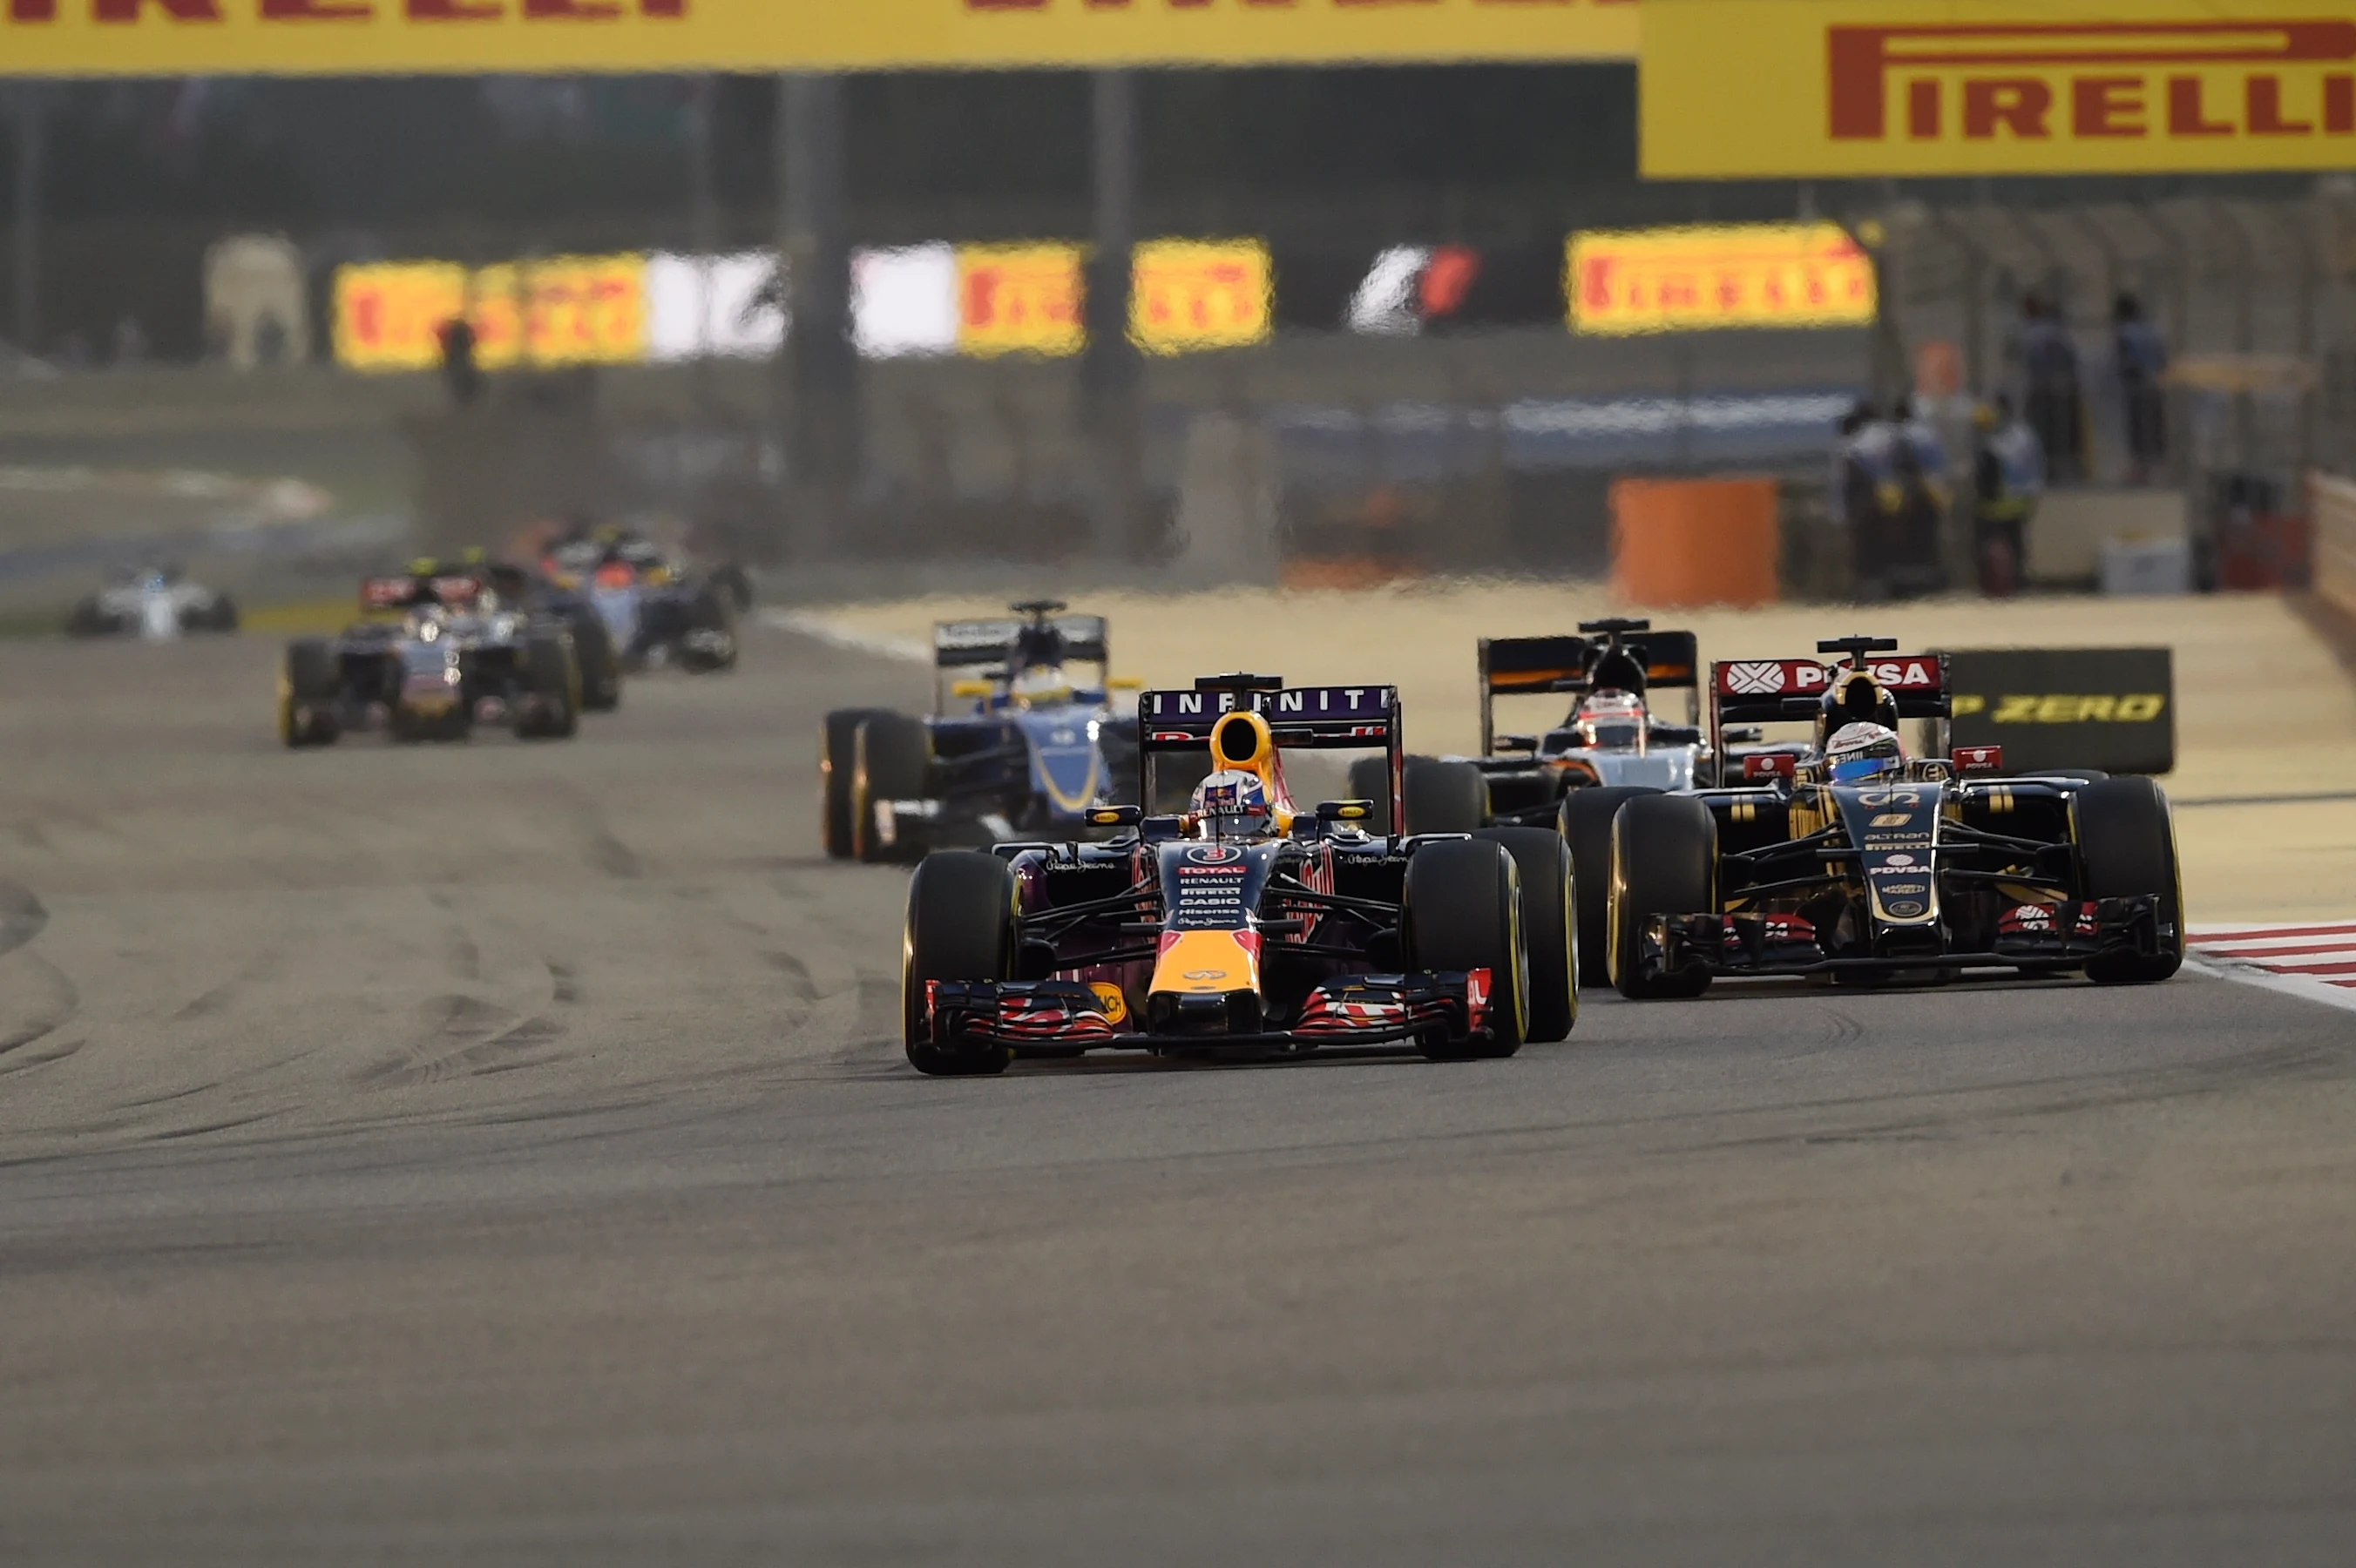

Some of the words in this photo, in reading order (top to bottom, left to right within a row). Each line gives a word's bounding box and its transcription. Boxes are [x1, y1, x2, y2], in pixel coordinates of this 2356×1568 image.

[1827, 21, 2356, 139] PIRELLI
[1153, 688, 1389, 714] INFINITI
[1991, 694, 2164, 723] ZERO
[1196, 805, 1246, 818] RENAULT
[1202, 846, 1227, 862] 3
[1180, 866, 1246, 875] TOTAL
[1869, 865, 1932, 875] PDVSA
[1180, 887, 1242, 896] PIRELLI
